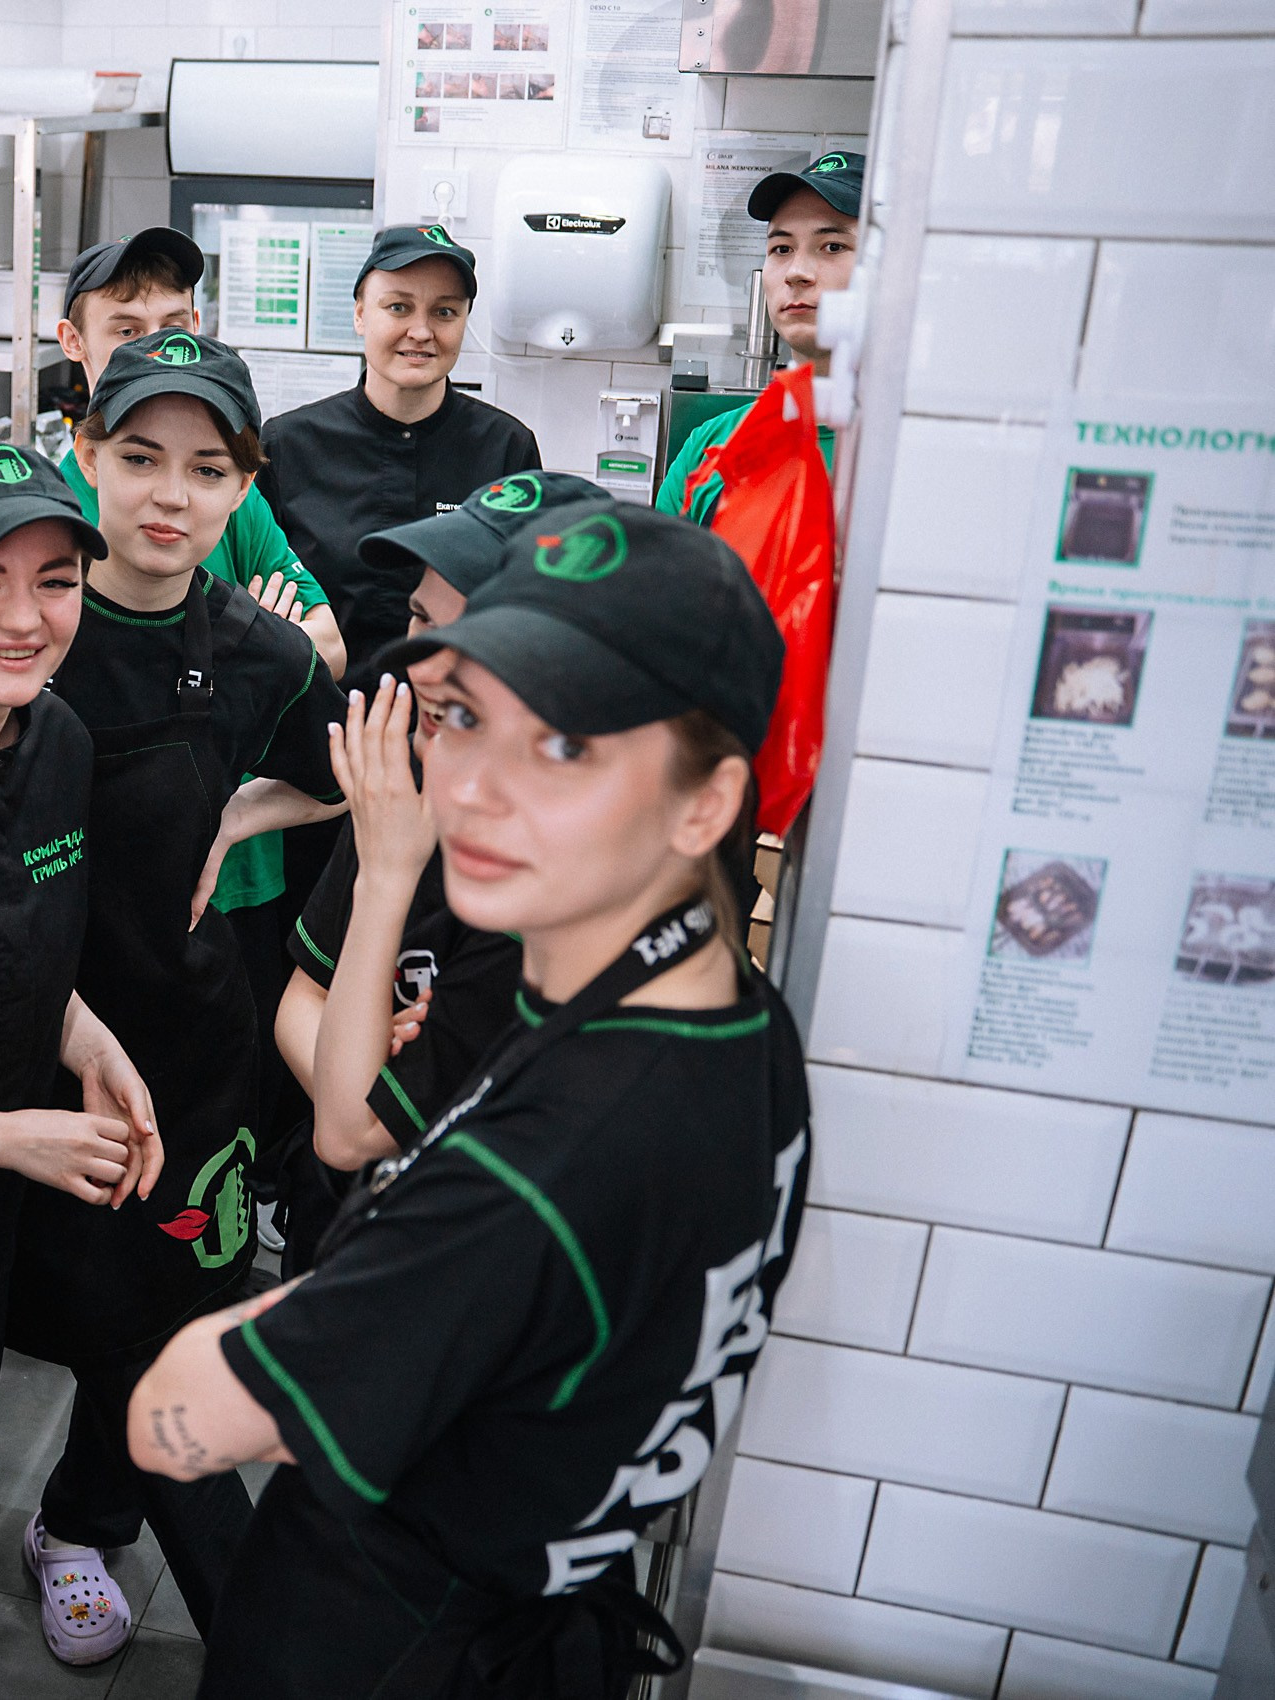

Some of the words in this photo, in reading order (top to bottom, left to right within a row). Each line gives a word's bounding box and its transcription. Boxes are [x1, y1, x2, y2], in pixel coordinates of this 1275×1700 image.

[562, 219, 601, 228] Electrolux
[23, 827, 84, 866] КОМАНДА
[32, 858, 68, 883] ГРИЛЬ
[69, 847, 83, 866] №1
